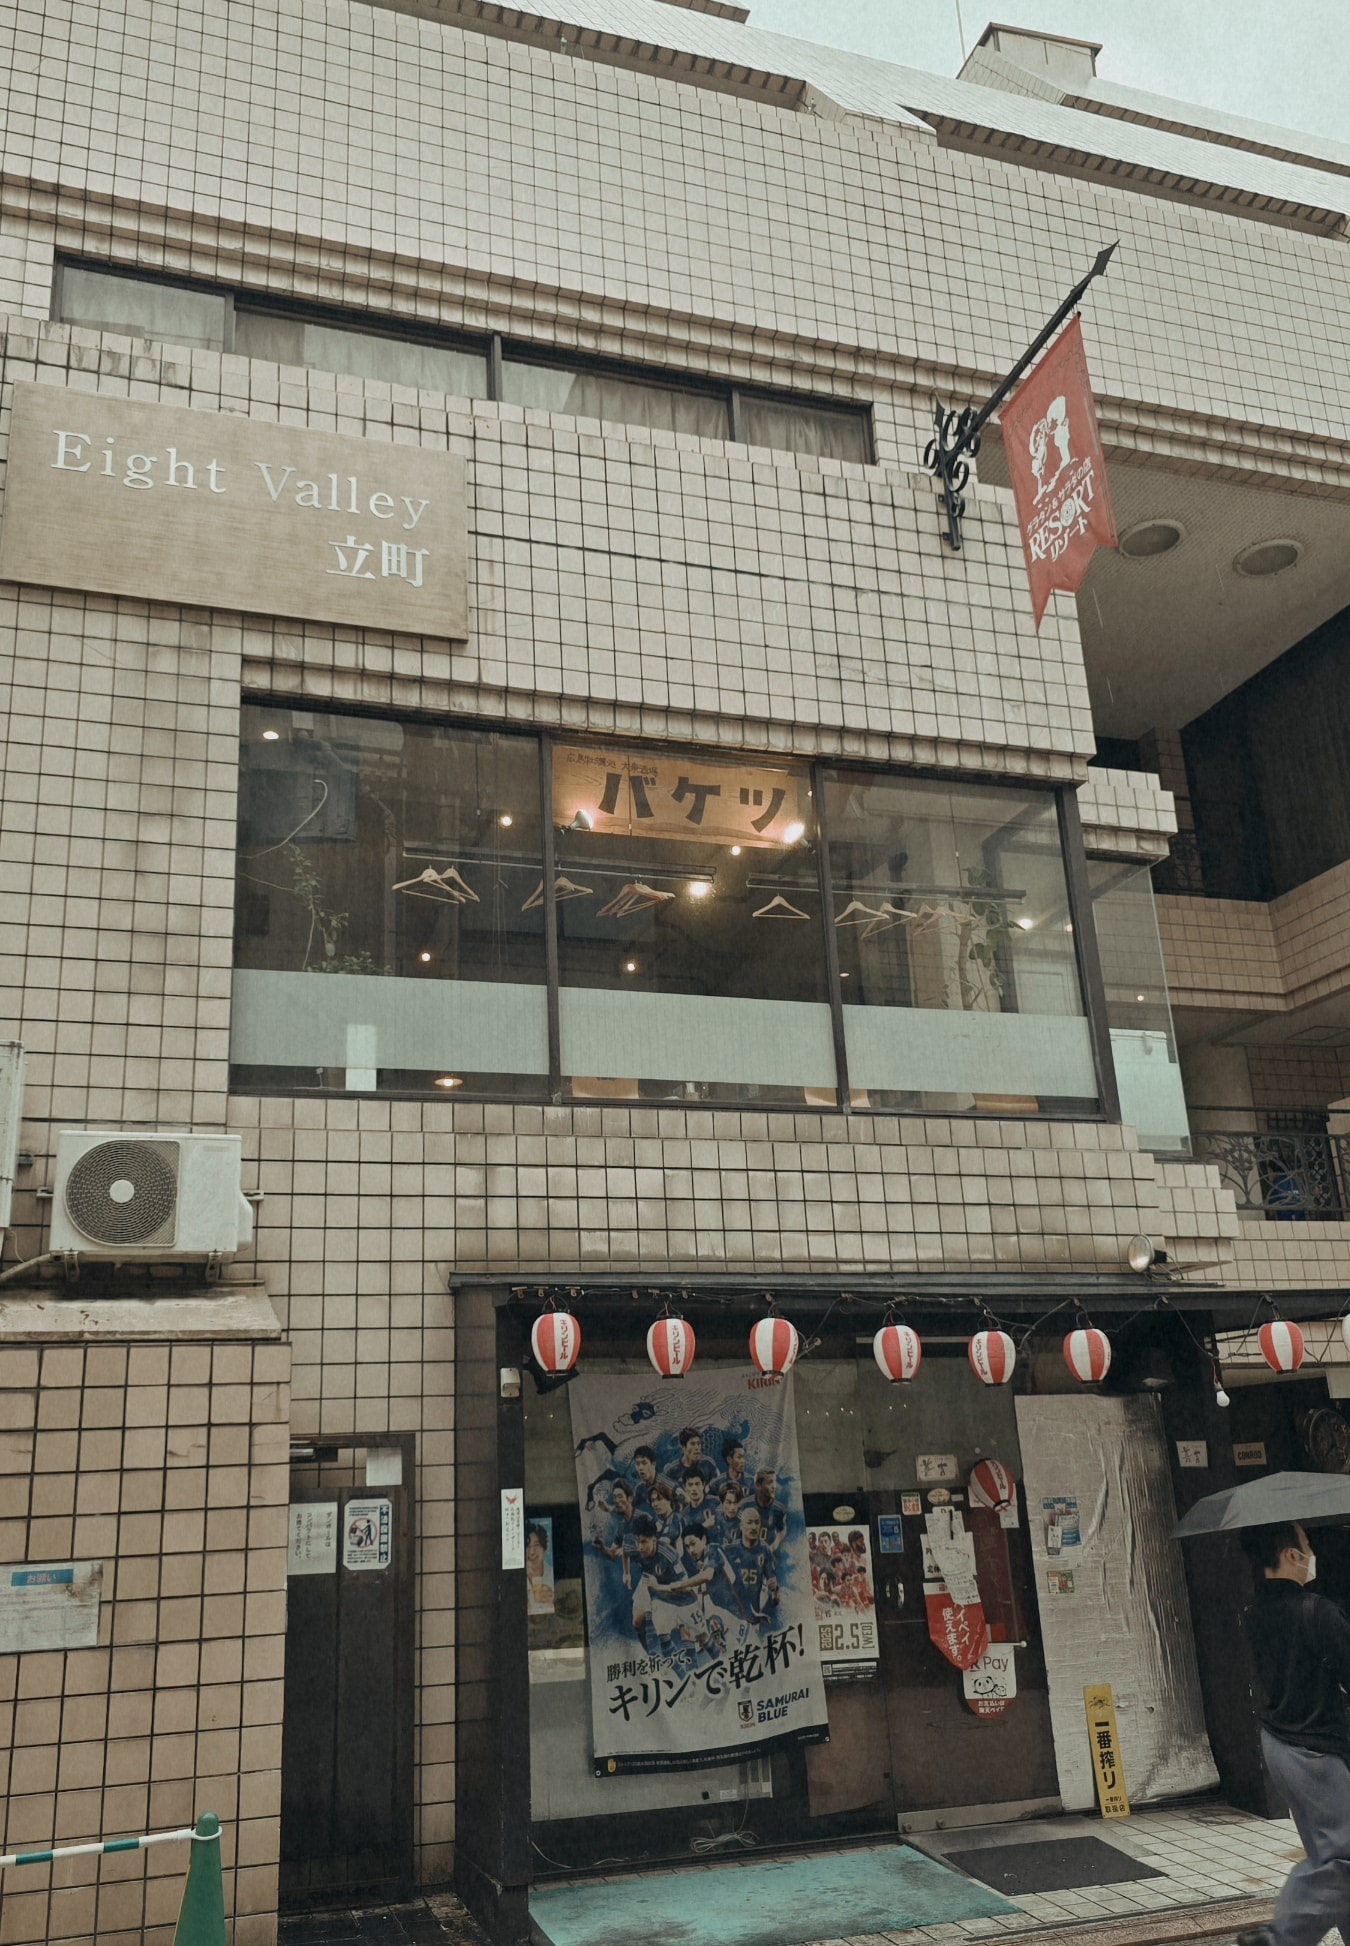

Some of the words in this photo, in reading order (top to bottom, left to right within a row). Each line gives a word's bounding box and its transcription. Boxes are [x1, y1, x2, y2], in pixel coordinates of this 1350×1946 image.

[51, 430, 227, 494] Eight
[255, 462, 430, 530] Valley
[1029, 469, 1095, 562] RESORT
[325, 535, 430, 588] 立町
[598, 772, 786, 833] バケツ
[740, 1568, 758, 1585] 25
[821, 1627, 832, 1650] 2025
[834, 1623, 860, 1650] 2.5
[942, 1607, 962, 1661] 使えます。
[606, 1648, 693, 1683] 勝利を祈って、
[983, 1656, 1009, 1672] Pay
[757, 1688, 810, 1711] SAMURAI
[758, 1705, 788, 1723] BLUE
[1095, 1721, 1116, 1790] 一番搾り
